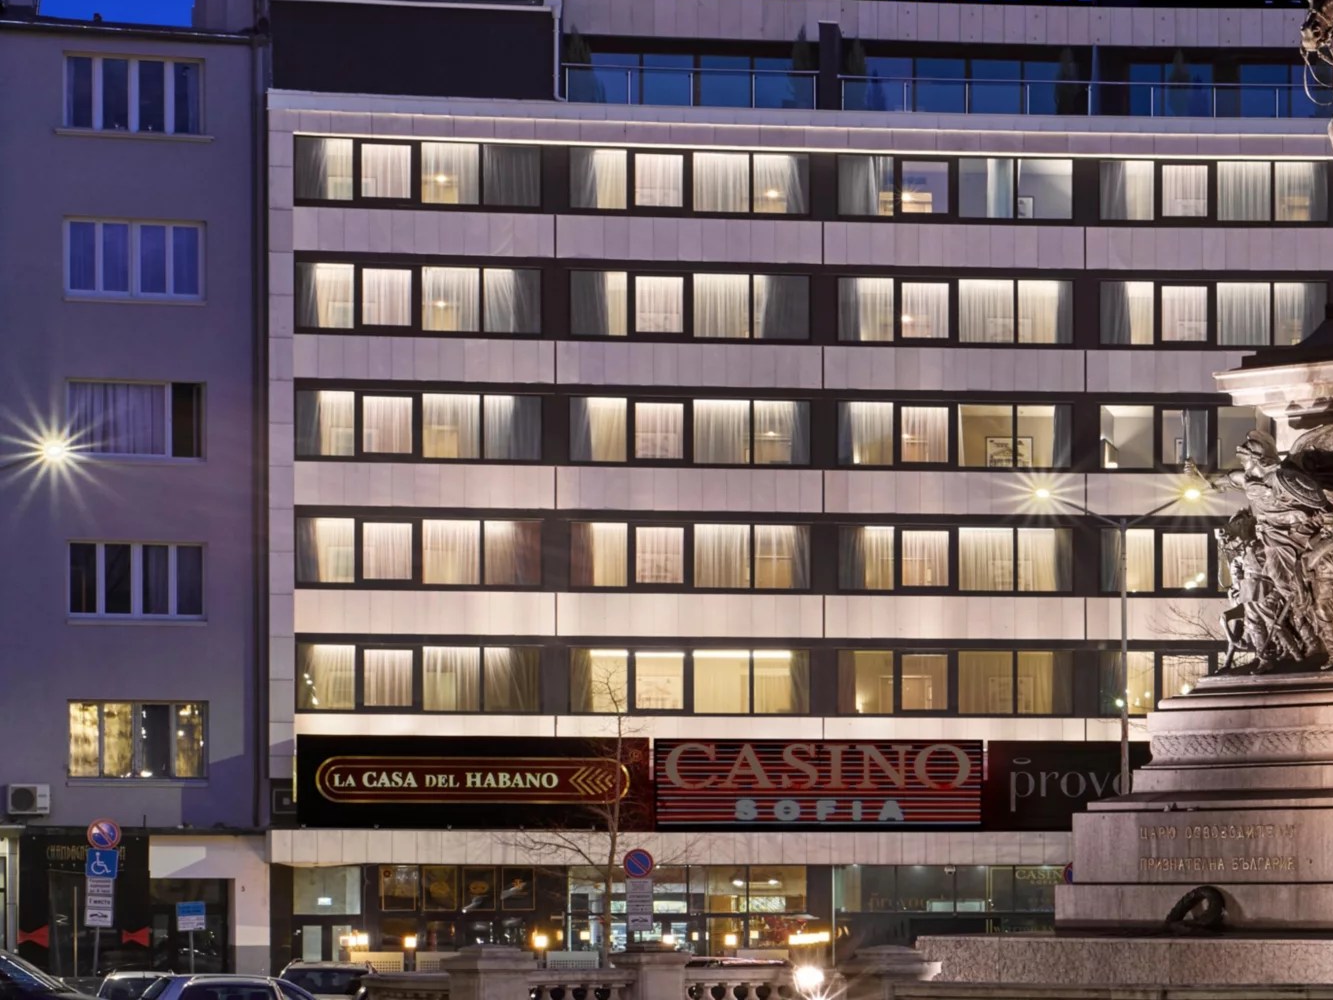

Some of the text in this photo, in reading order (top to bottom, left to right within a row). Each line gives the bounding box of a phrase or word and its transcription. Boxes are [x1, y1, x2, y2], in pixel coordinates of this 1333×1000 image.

[664, 742, 972, 790] CASINO
[333, 771, 559, 788] LA CASA DEL HABANO
[734, 799, 905, 821] SOFIA
[1140, 825, 1177, 839] ЦАРЮ
[1140, 857, 1225, 870] ПРИЗНАТЕЛНА
[1015, 869, 1063, 880] CASIN
